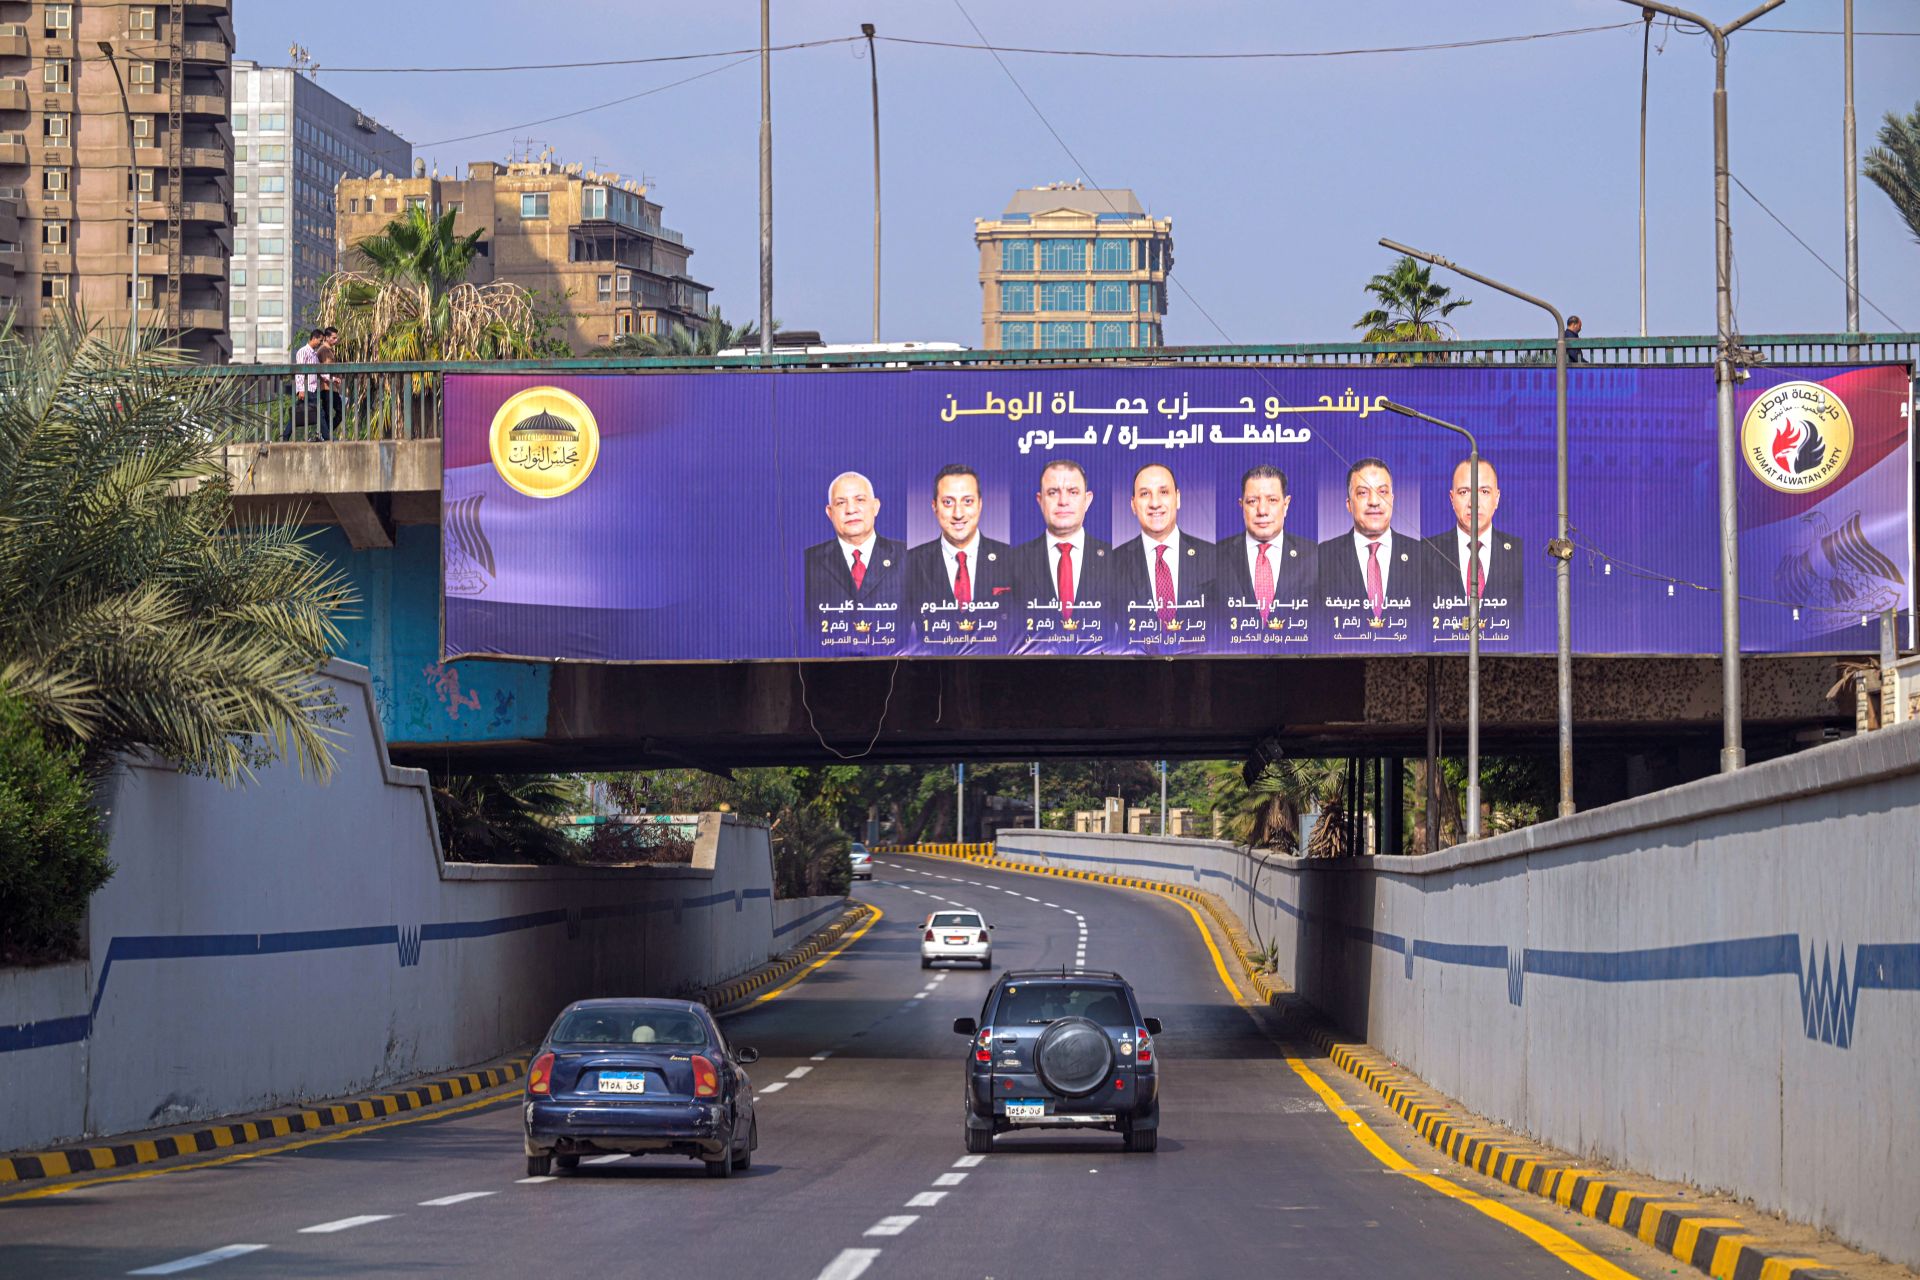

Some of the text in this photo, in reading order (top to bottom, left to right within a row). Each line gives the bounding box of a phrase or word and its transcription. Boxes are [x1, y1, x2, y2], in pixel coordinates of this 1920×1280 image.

[941, 388, 1389, 421] مرشحو حزب حماة الوطن
[1758, 392, 1788, 419] الوطن
[1018, 424, 1311, 454] محافظة الجيزة / فردي
[509, 445, 579, 470] مجلس النواب
[1753, 447, 1842, 485] HUMAT ALWATAN PARTY
[819, 600, 898, 613] محمد كليب
[921, 599, 999, 614] محمود لملوم
[1027, 598, 1102, 612] محمد رشاد
[1167, 594, 1204, 609] أحمد
[1228, 596, 1308, 612] عربي زيادة
[1325, 596, 1360, 609] عريضة
[1381, 596, 1411, 609] فيصل
[821, 620, 895, 633] رمز رقم 2
[923, 619, 997, 632] رمز رقم 1
[1026, 618, 1100, 631] رمز رقم 2
[1129, 618, 1205, 632] رمز رقم 2
[1230, 617, 1308, 630] رمز رقم 3
[1334, 616, 1407, 629] رمز رقم 1
[1432, 616, 1440, 629] 2
[1490, 616, 1510, 629] رمز
[822, 636, 851, 646] النمرس
[872, 636, 895, 645] مركز
[924, 634, 997, 644] قسم العمرانية
[1025, 634, 1102, 644] مركز البدرشين
[1178, 636, 1205, 645] قسم
[1231, 633, 1308, 644] قسم بولاق الدكرور
[1334, 632, 1407, 642] مركز الصف
